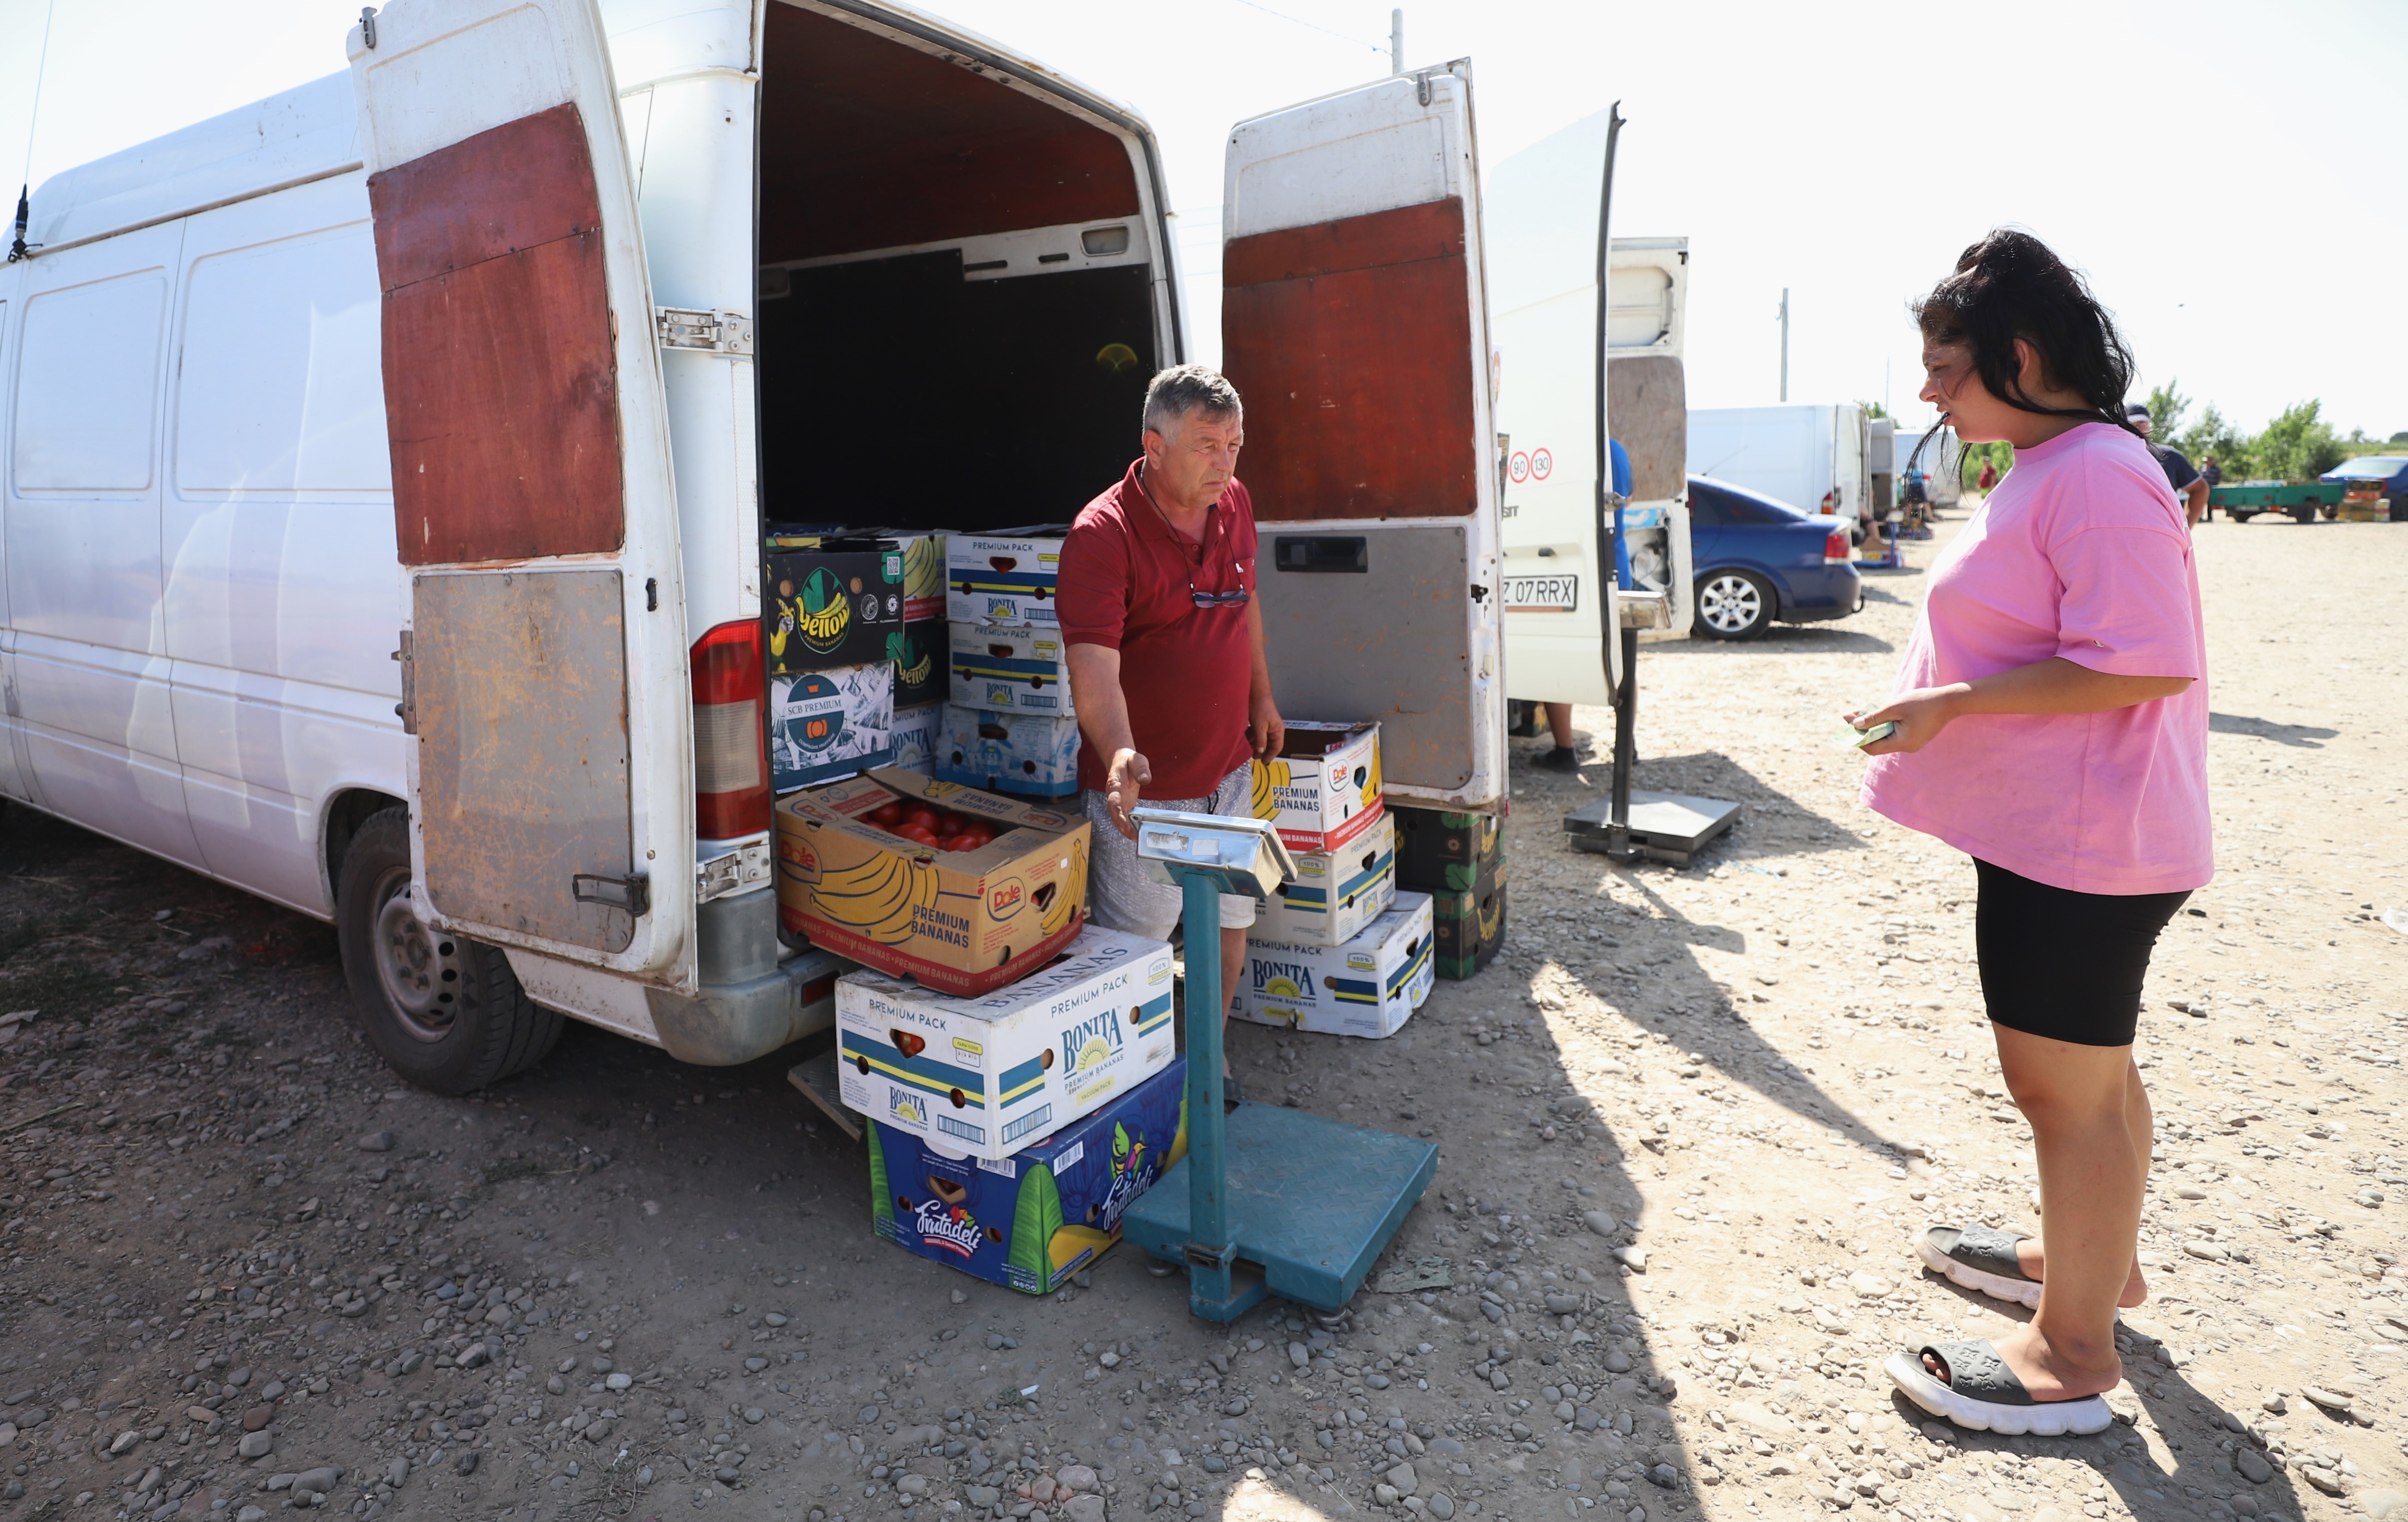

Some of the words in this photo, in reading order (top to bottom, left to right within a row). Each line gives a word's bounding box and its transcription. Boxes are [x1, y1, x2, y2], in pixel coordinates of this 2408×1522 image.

[1514, 461, 1525, 474] 90
[1534, 457, 1549, 471] 130
[973, 542, 1010, 551] PREMIUM
[1012, 543, 1033, 552] PACK
[988, 598, 1017, 616] BONITA
[804, 635, 824, 647] PREMIUM
[825, 632, 844, 646] BANANAS
[975, 627, 1008, 637] PREMIUM
[987, 682, 1014, 701] BONITA
[788, 705, 803, 715] SCB
[805, 699, 841, 713] PREMIUM
[893, 711, 916, 723] EMIUM
[917, 707, 936, 717] PACK
[1333, 765, 1347, 781] Dole
[962, 793, 1013, 811] BANANAS
[1273, 787, 1318, 799] PREMIUM
[801, 805, 833, 821] Dole
[952, 798, 1005, 815] PREMIUM
[1274, 799, 1320, 811] BANANAS
[1292, 835, 1322, 844] BANANAS
[1351, 836, 1371, 854] PREMIUM
[1372, 829, 1382, 840] PACK
[781, 840, 815, 868] Dole
[994, 885, 1021, 909] Dole
[913, 904, 969, 932] PREMIUM
[911, 921, 969, 948] BANANAS
[1397, 924, 1414, 945] PREMIUM
[1247, 938, 1290, 952] REMIUM
[1294, 946, 1322, 956] PACK
[826, 929, 857, 949] PREMIUM
[857, 941, 890, 961] BANANAS
[894, 958, 930, 975] PREMIUM
[931, 969, 969, 987] BANANAS
[989, 961, 1017, 982] PREMIUM
[1017, 948, 1041, 969] BANANAS
[1152, 962, 1166, 972] 100%
[978, 947, 1128, 1008] BANANAS
[1151, 970, 1169, 981] ECUADOR
[1252, 959, 1316, 996] BONITA
[1051, 987, 1099, 1018] PREMIUM
[1103, 974, 1128, 994] PACK
[1254, 994, 1283, 1003] PREMIUM
[1285, 999, 1316, 1008] BANANAS
[869, 999, 915, 1022] PREMIUM
[919, 1014, 946, 1031] PACK
[1061, 1008, 1123, 1075] BONITA
[1064, 1070, 1094, 1091] PREMIUM
[1096, 1054, 1124, 1075] BANANAS
[1081, 1086, 1099, 1100] VACUUM
[1100, 1081, 1111, 1089] PACK
[889, 1086, 928, 1122] BONITA
[890, 1114, 908, 1124] PREMIUM
[908, 1121, 928, 1131] BANANAS
[1102, 1165, 1153, 1230] Frutadeli
[914, 1200, 982, 1249] Frutadeli
[1051, 1268, 1068, 1284] PRODUCT
